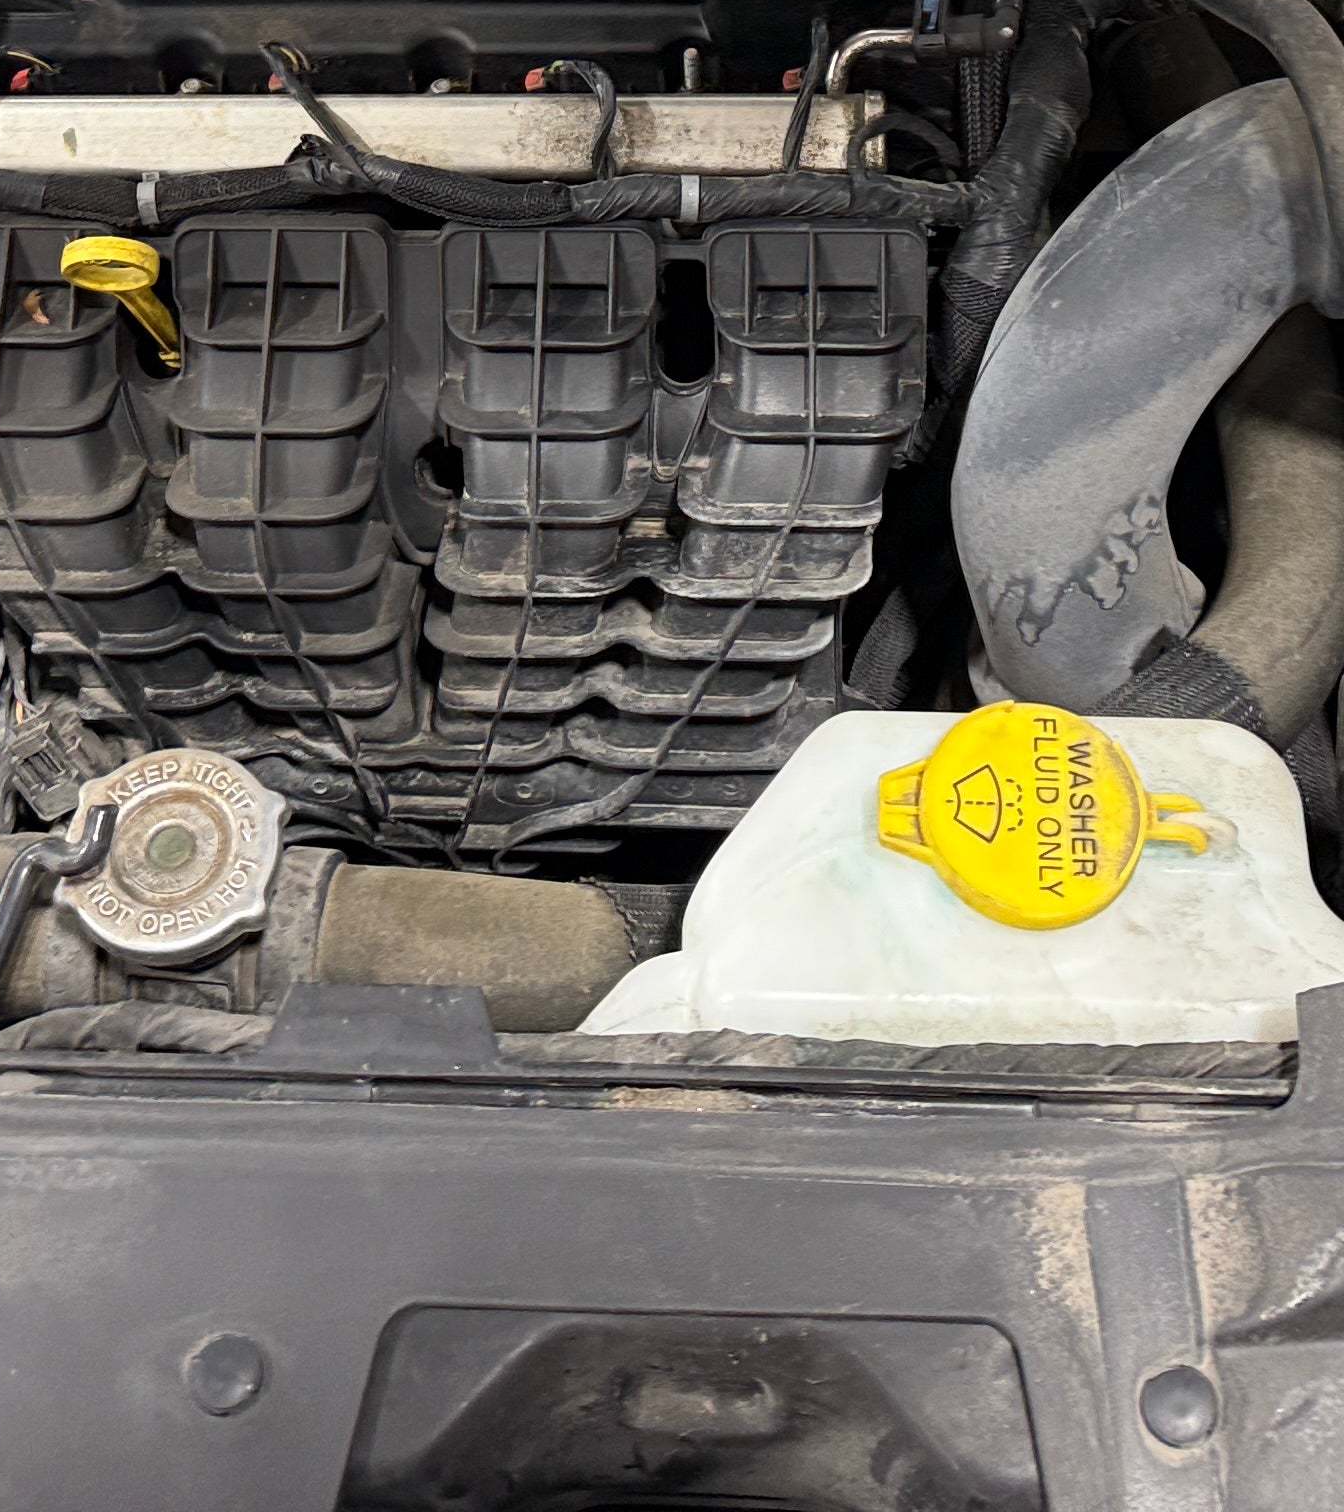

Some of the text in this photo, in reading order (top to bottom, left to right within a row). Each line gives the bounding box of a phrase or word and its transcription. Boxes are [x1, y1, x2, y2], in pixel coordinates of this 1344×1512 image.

[107, 760, 256, 810] KEEP TIGHT
[1033, 717, 1065, 899] FLUID ONLY
[1067, 741, 1098, 878] WASHER
[87, 857, 257, 935] NOT OPEN HOT
